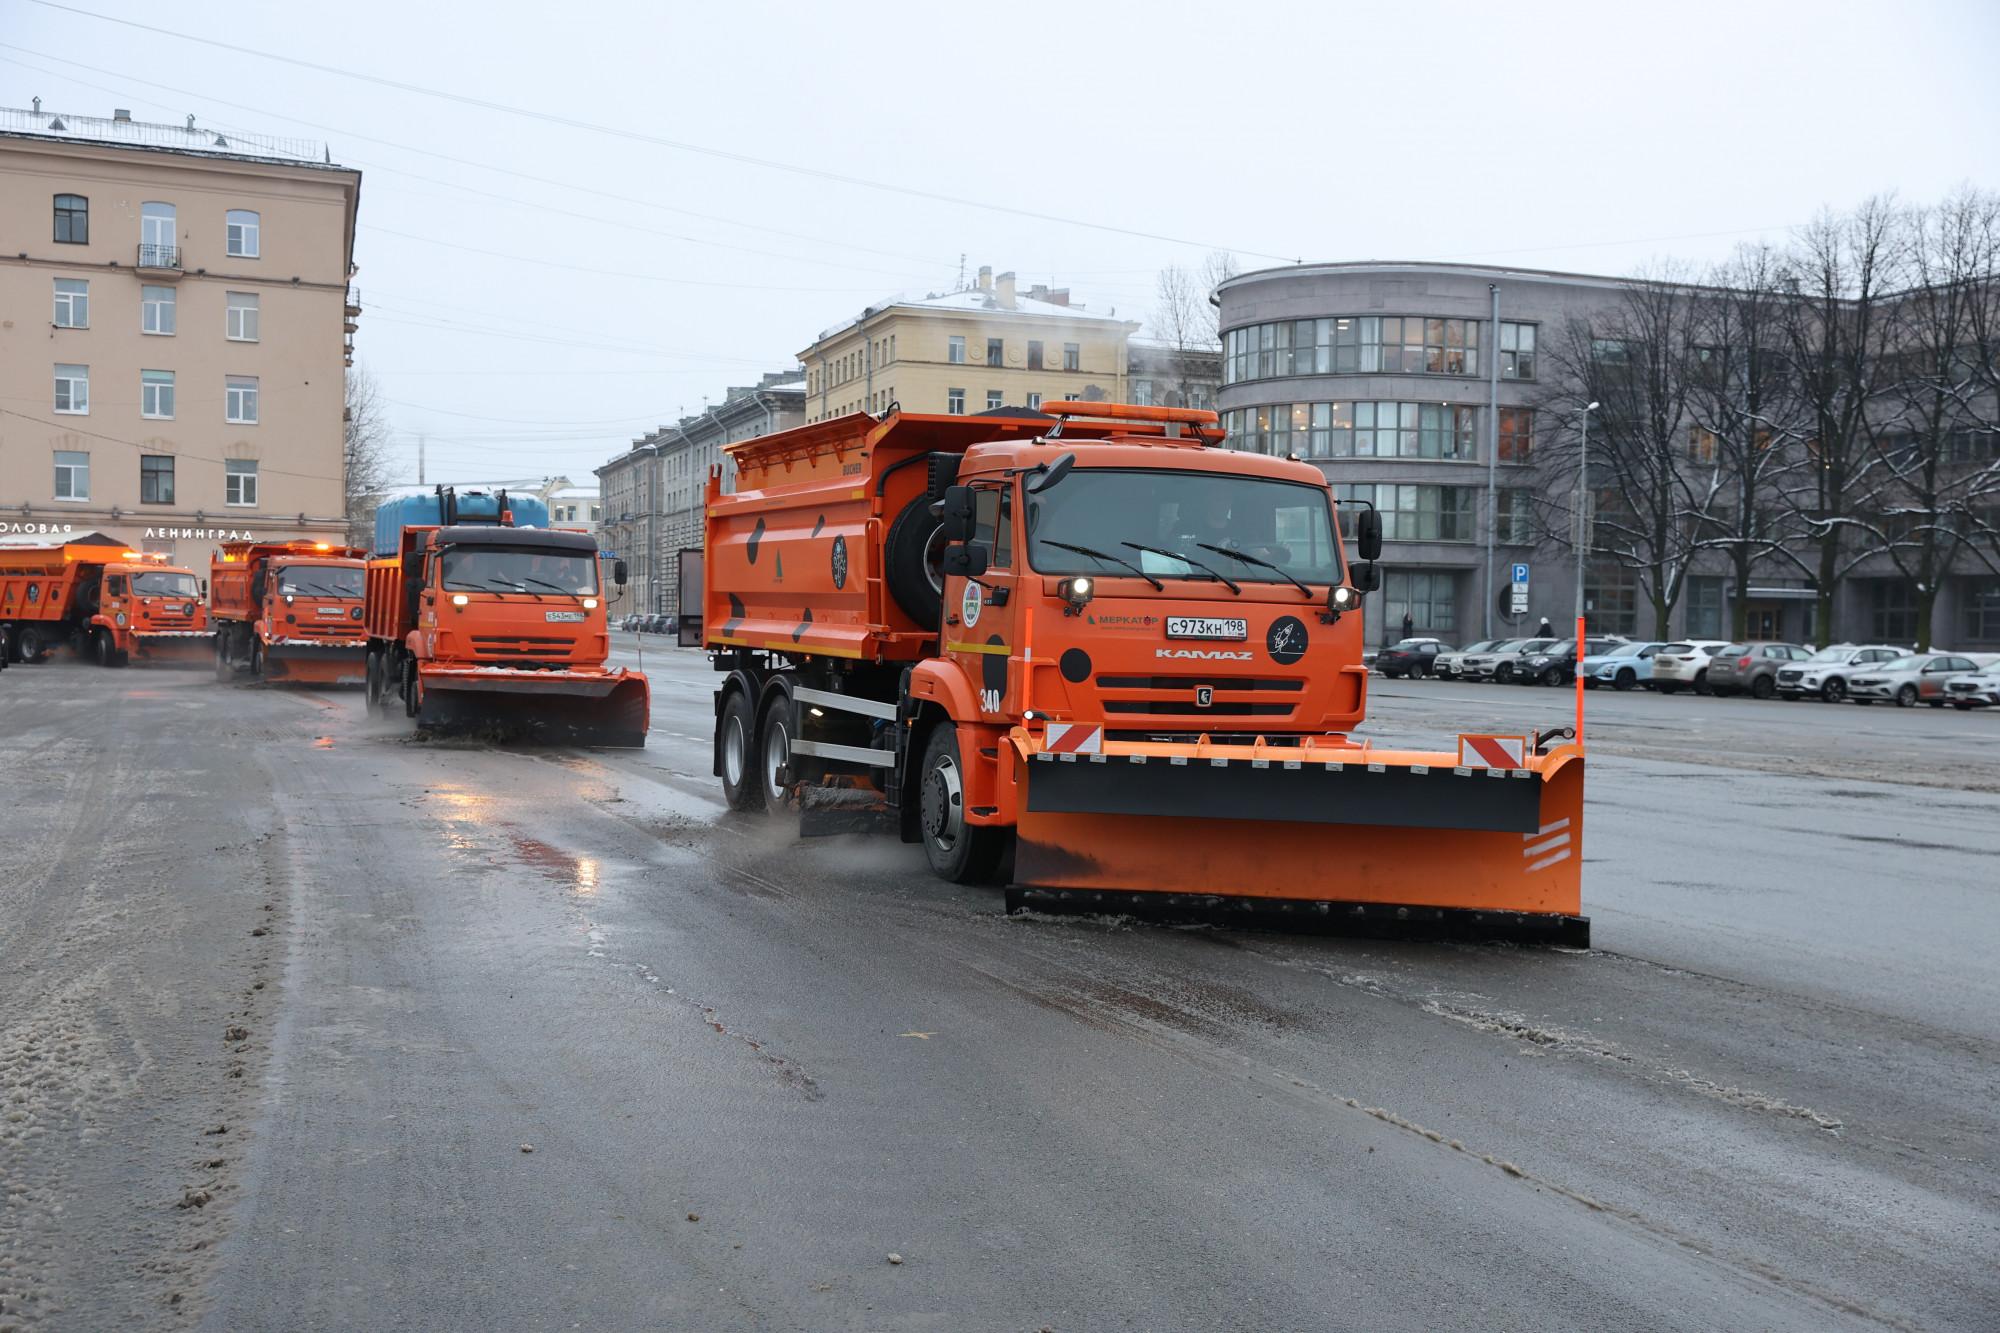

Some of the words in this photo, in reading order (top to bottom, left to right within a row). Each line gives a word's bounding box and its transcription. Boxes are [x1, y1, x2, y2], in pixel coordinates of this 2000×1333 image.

[843, 463, 862, 476] BUCHER
[145, 527, 253, 540] ЛЕНИНГРАД
[1099, 616, 1159, 626] МЕРКАТОР
[1171, 619, 1222, 634] С973КН
[1225, 620, 1243, 631] 198
[1155, 648, 1253, 661] KAMAZ
[980, 689, 1000, 714] 340
